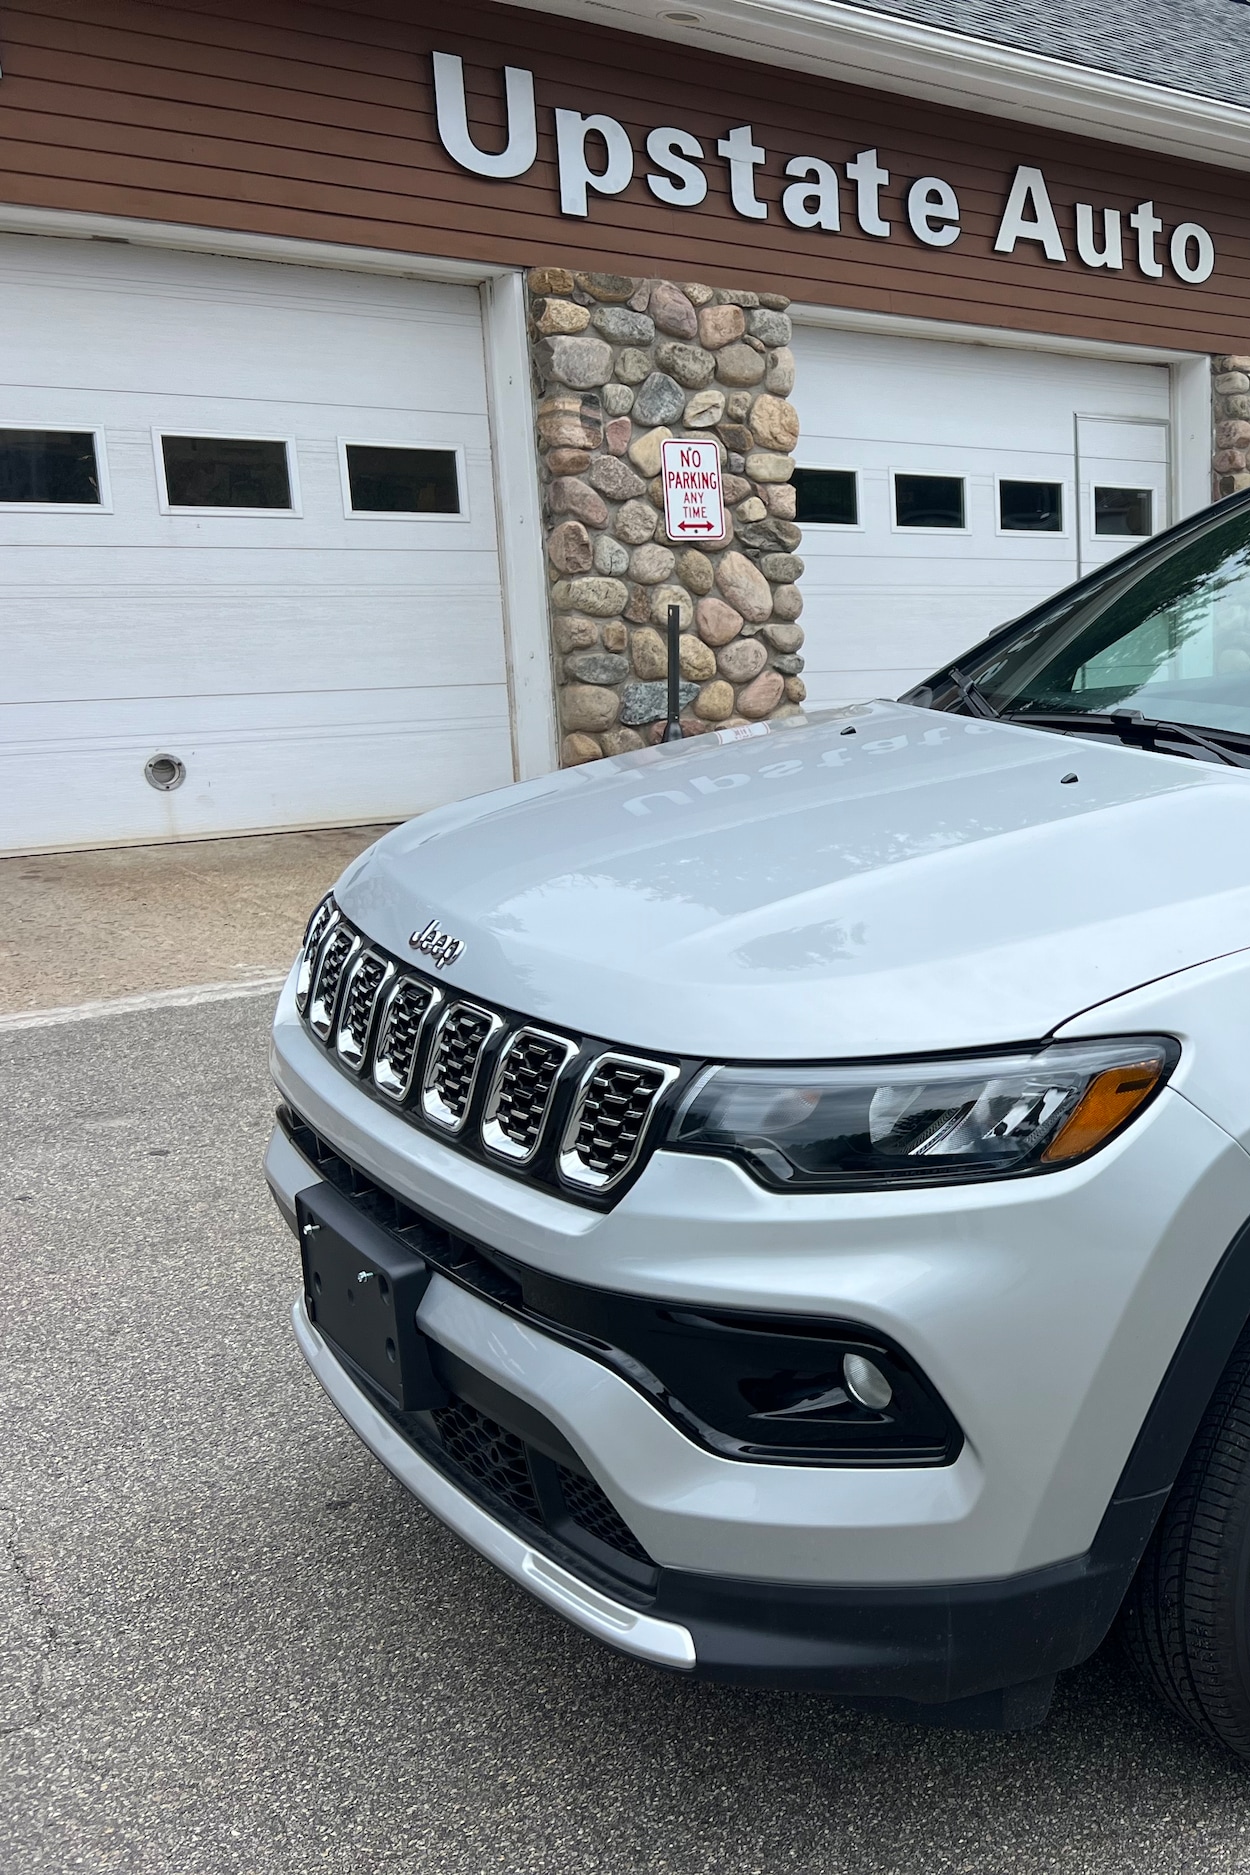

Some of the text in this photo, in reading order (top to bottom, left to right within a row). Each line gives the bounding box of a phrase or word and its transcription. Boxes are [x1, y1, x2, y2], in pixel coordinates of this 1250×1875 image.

[431, 50, 1216, 284] Upstate Auto
[680, 449, 702, 468] NO
[668, 471, 717, 490] PARKING
[683, 492, 705, 504] ANY
[683, 506, 708, 519] TIME
[408, 919, 466, 971] Jeep
